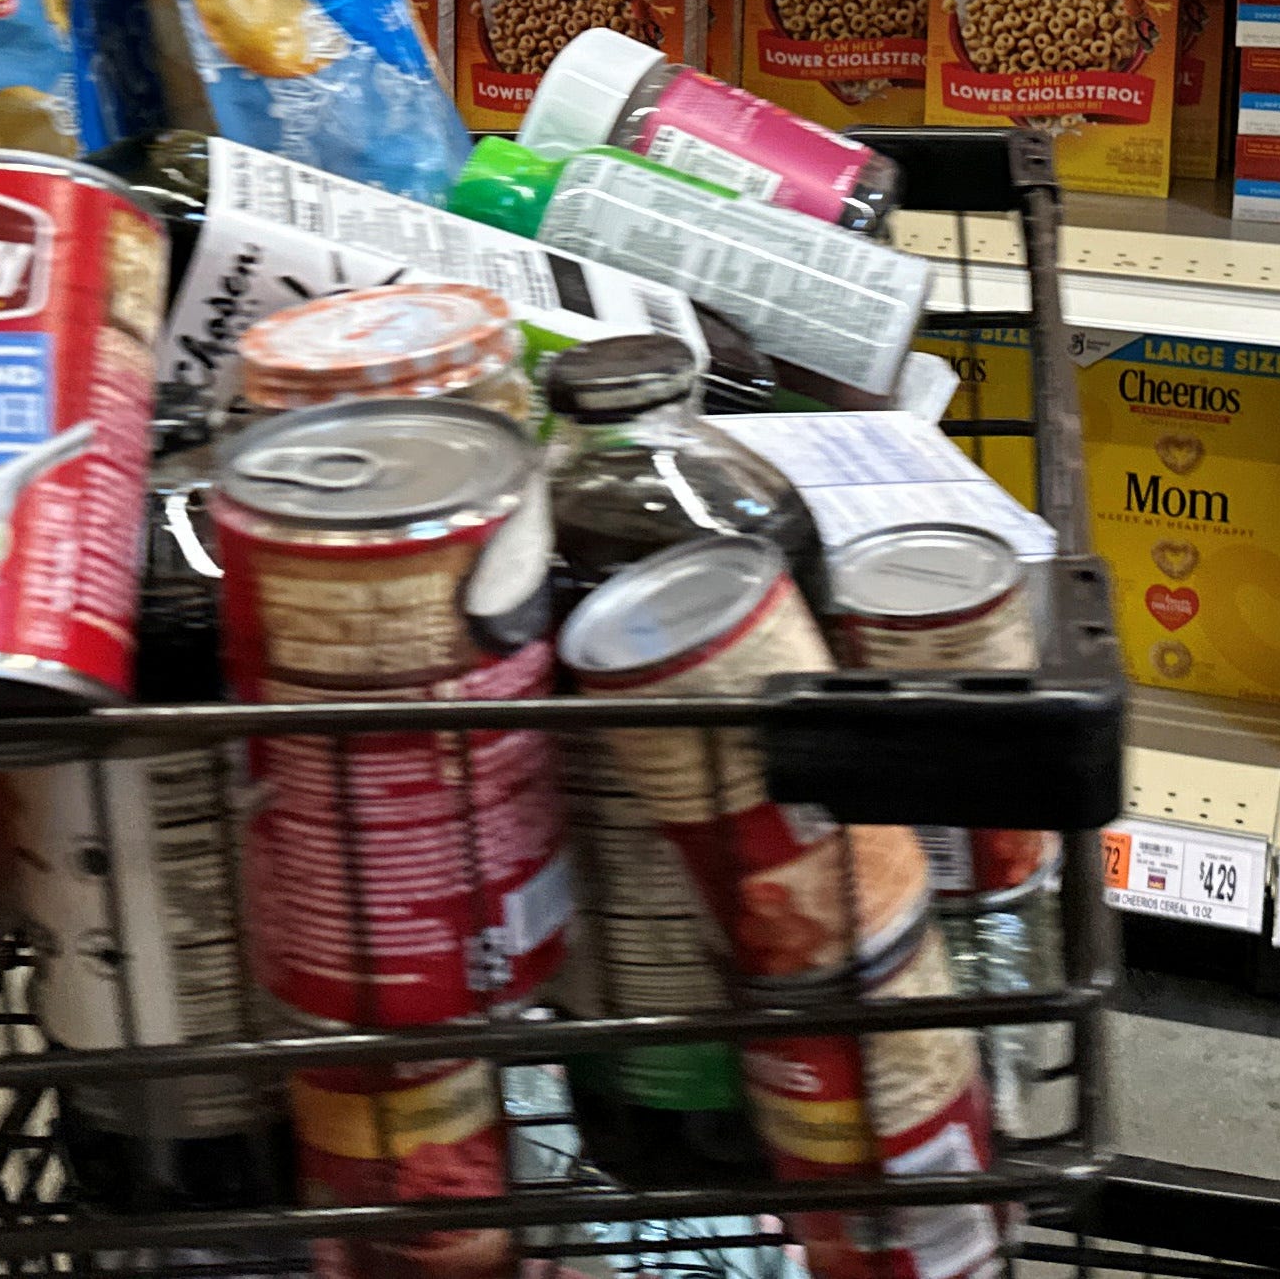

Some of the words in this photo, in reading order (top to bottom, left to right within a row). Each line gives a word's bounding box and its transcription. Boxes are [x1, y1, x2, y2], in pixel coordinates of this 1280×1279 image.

[1013, 77, 1041, 88] CAN
[1044, 74, 1078, 85] HELP
[1144, 342, 1225, 368] LARGE
[1125, 472, 1230, 522] Mom
[1122, 894, 1158, 909] CHEERIOS
[1160, 899, 1188, 914] CEREAL
[1193, 906, 1200, 916] 12
[1202, 907, 1213, 919] OZ
